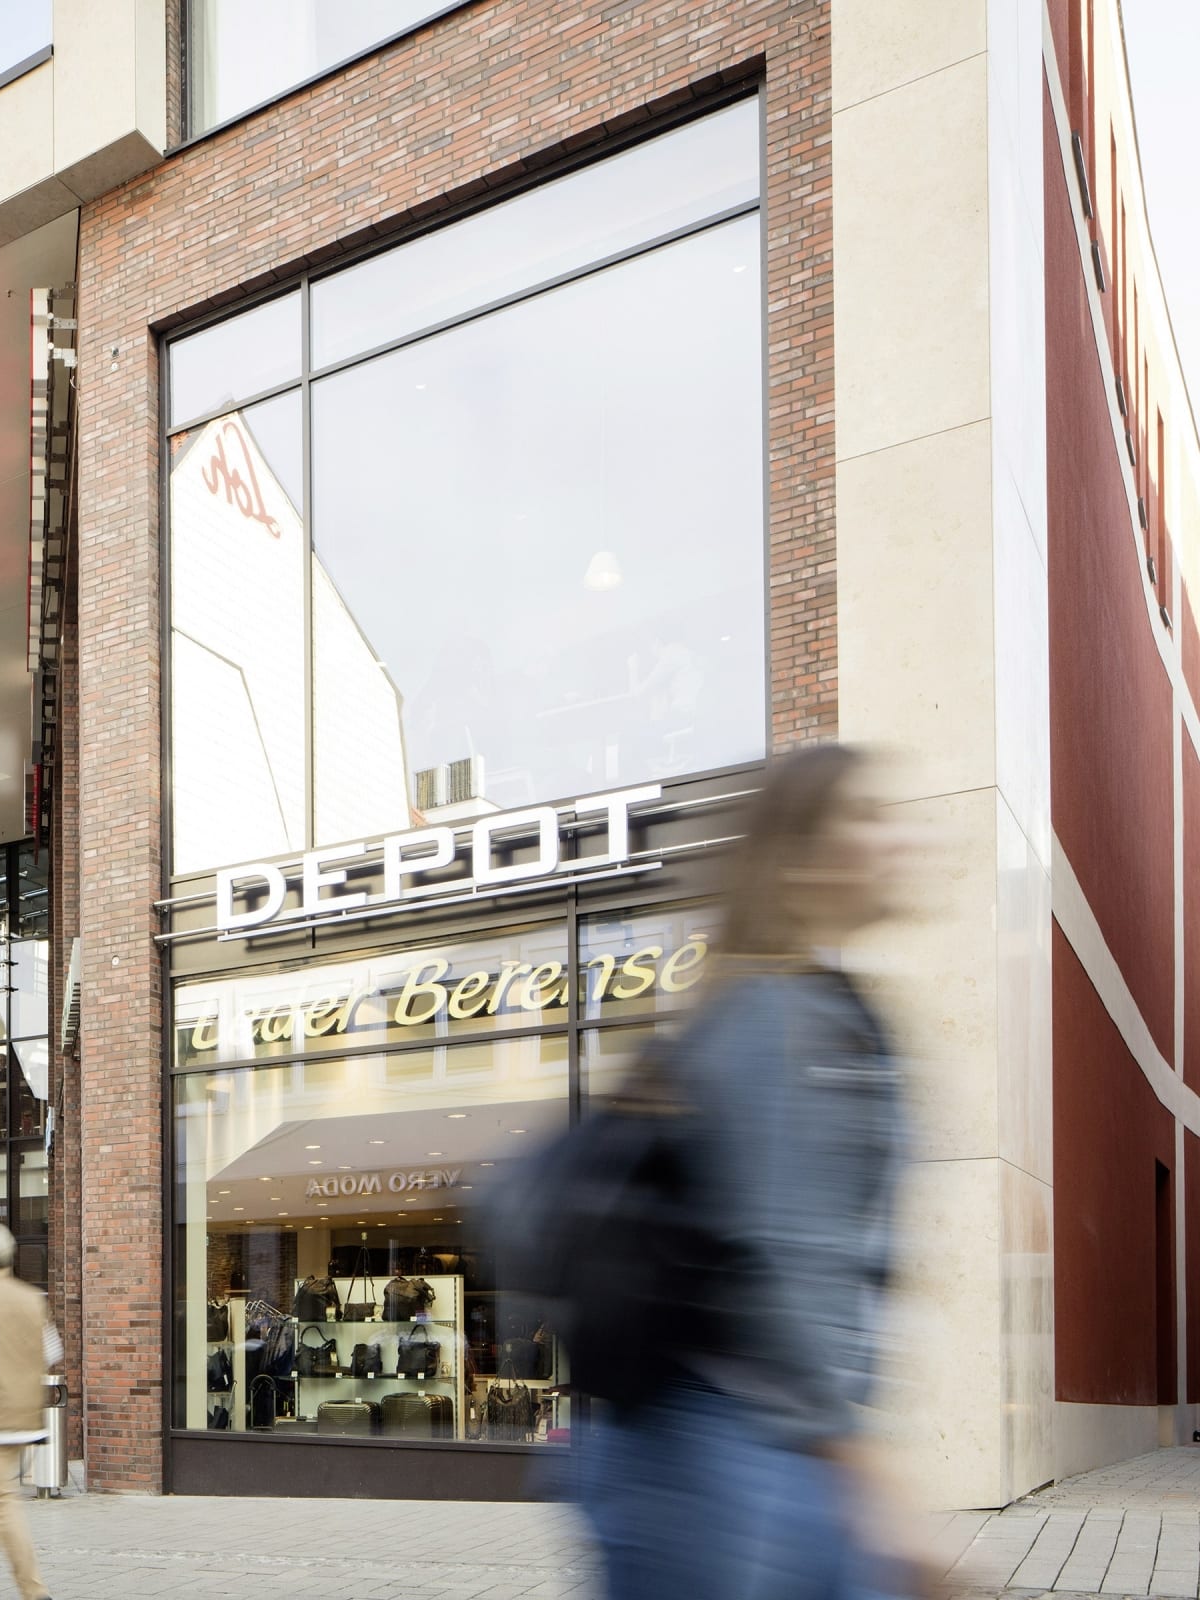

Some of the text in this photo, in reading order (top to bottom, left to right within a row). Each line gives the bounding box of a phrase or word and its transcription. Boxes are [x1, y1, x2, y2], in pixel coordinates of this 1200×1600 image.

[216, 784, 662, 931] DEPOT
[191, 941, 708, 1050] Lder Berense
